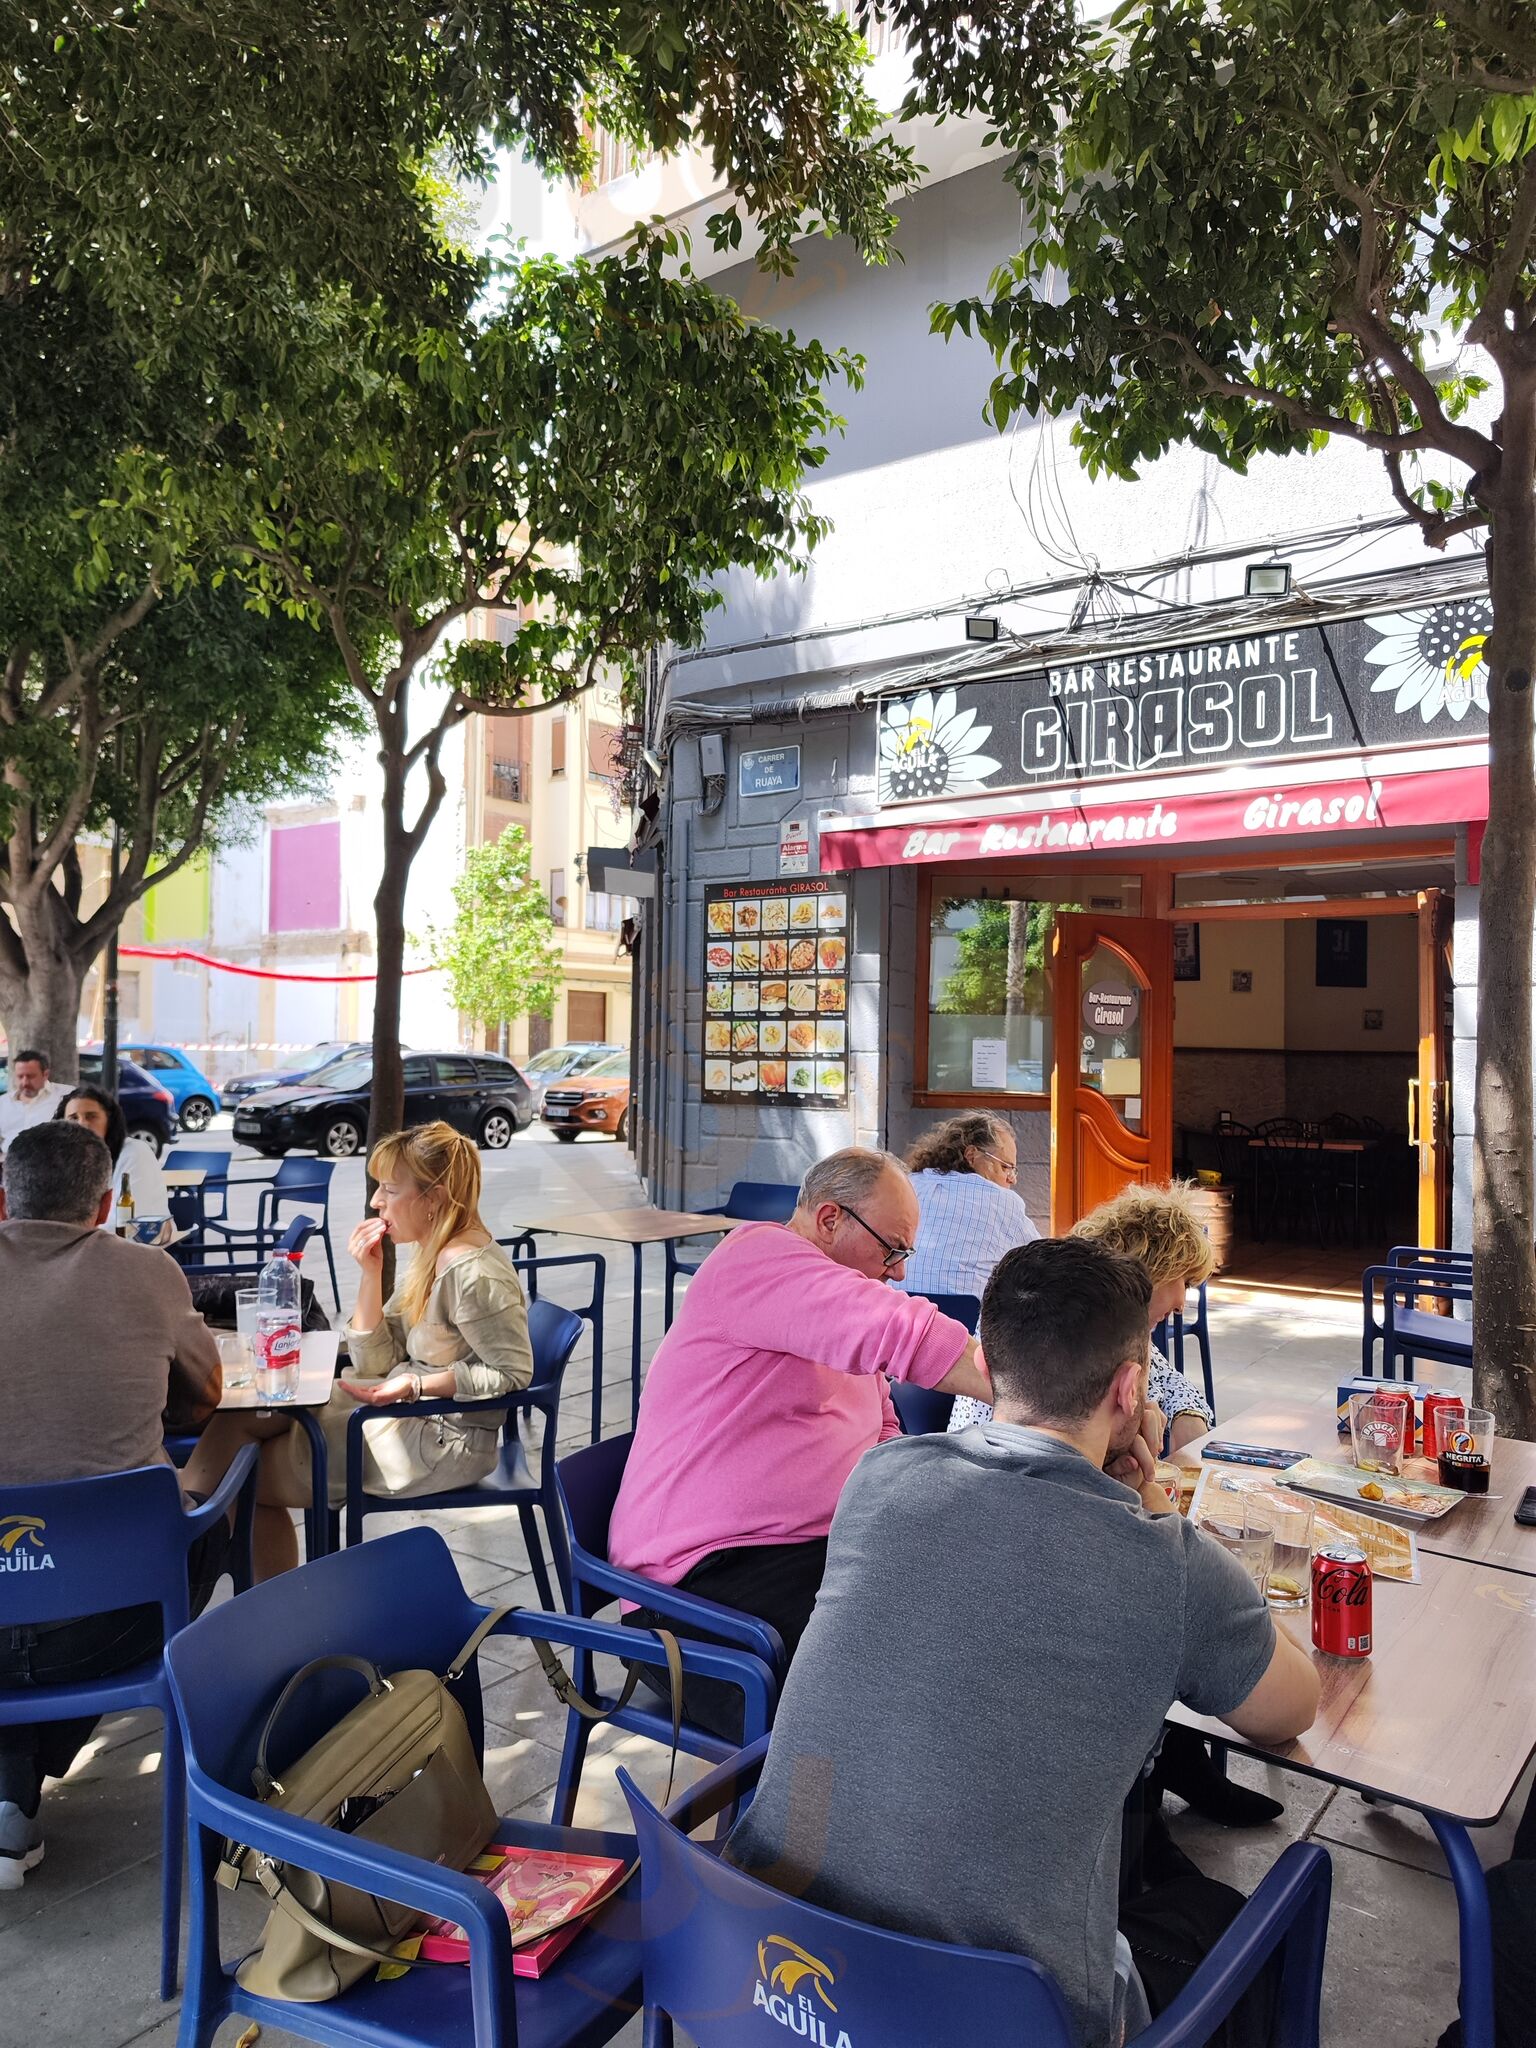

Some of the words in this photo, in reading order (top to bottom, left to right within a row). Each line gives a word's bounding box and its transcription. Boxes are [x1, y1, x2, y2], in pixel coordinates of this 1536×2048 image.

[1049, 667, 1095, 697] BAR
[1107, 633, 1300, 688] RESTAURANTE
[1021, 668, 1334, 774] GIRASOL
[758, 753, 785, 763] CARRER
[764, 766, 774, 774] DE
[755, 775, 783, 788] RUAYA
[902, 830, 960, 859] Bar
[978, 803, 1178, 855] Restaurante
[1243, 780, 1384, 831] Girasol
[723, 888, 737, 898] Bar
[740, 885, 788, 897] Restaurante
[790, 881, 829, 893] GIRASOL
[1088, 991, 1132, 1006] Bar-Restaurante
[1094, 1006, 1125, 1025] Girasol
[1362, 1423, 1397, 1438] BRUGAL
[1445, 1451, 1482, 1464] NEGRITA
[15, 1547, 29, 1556] EL
[798, 1993, 817, 2016] EL
